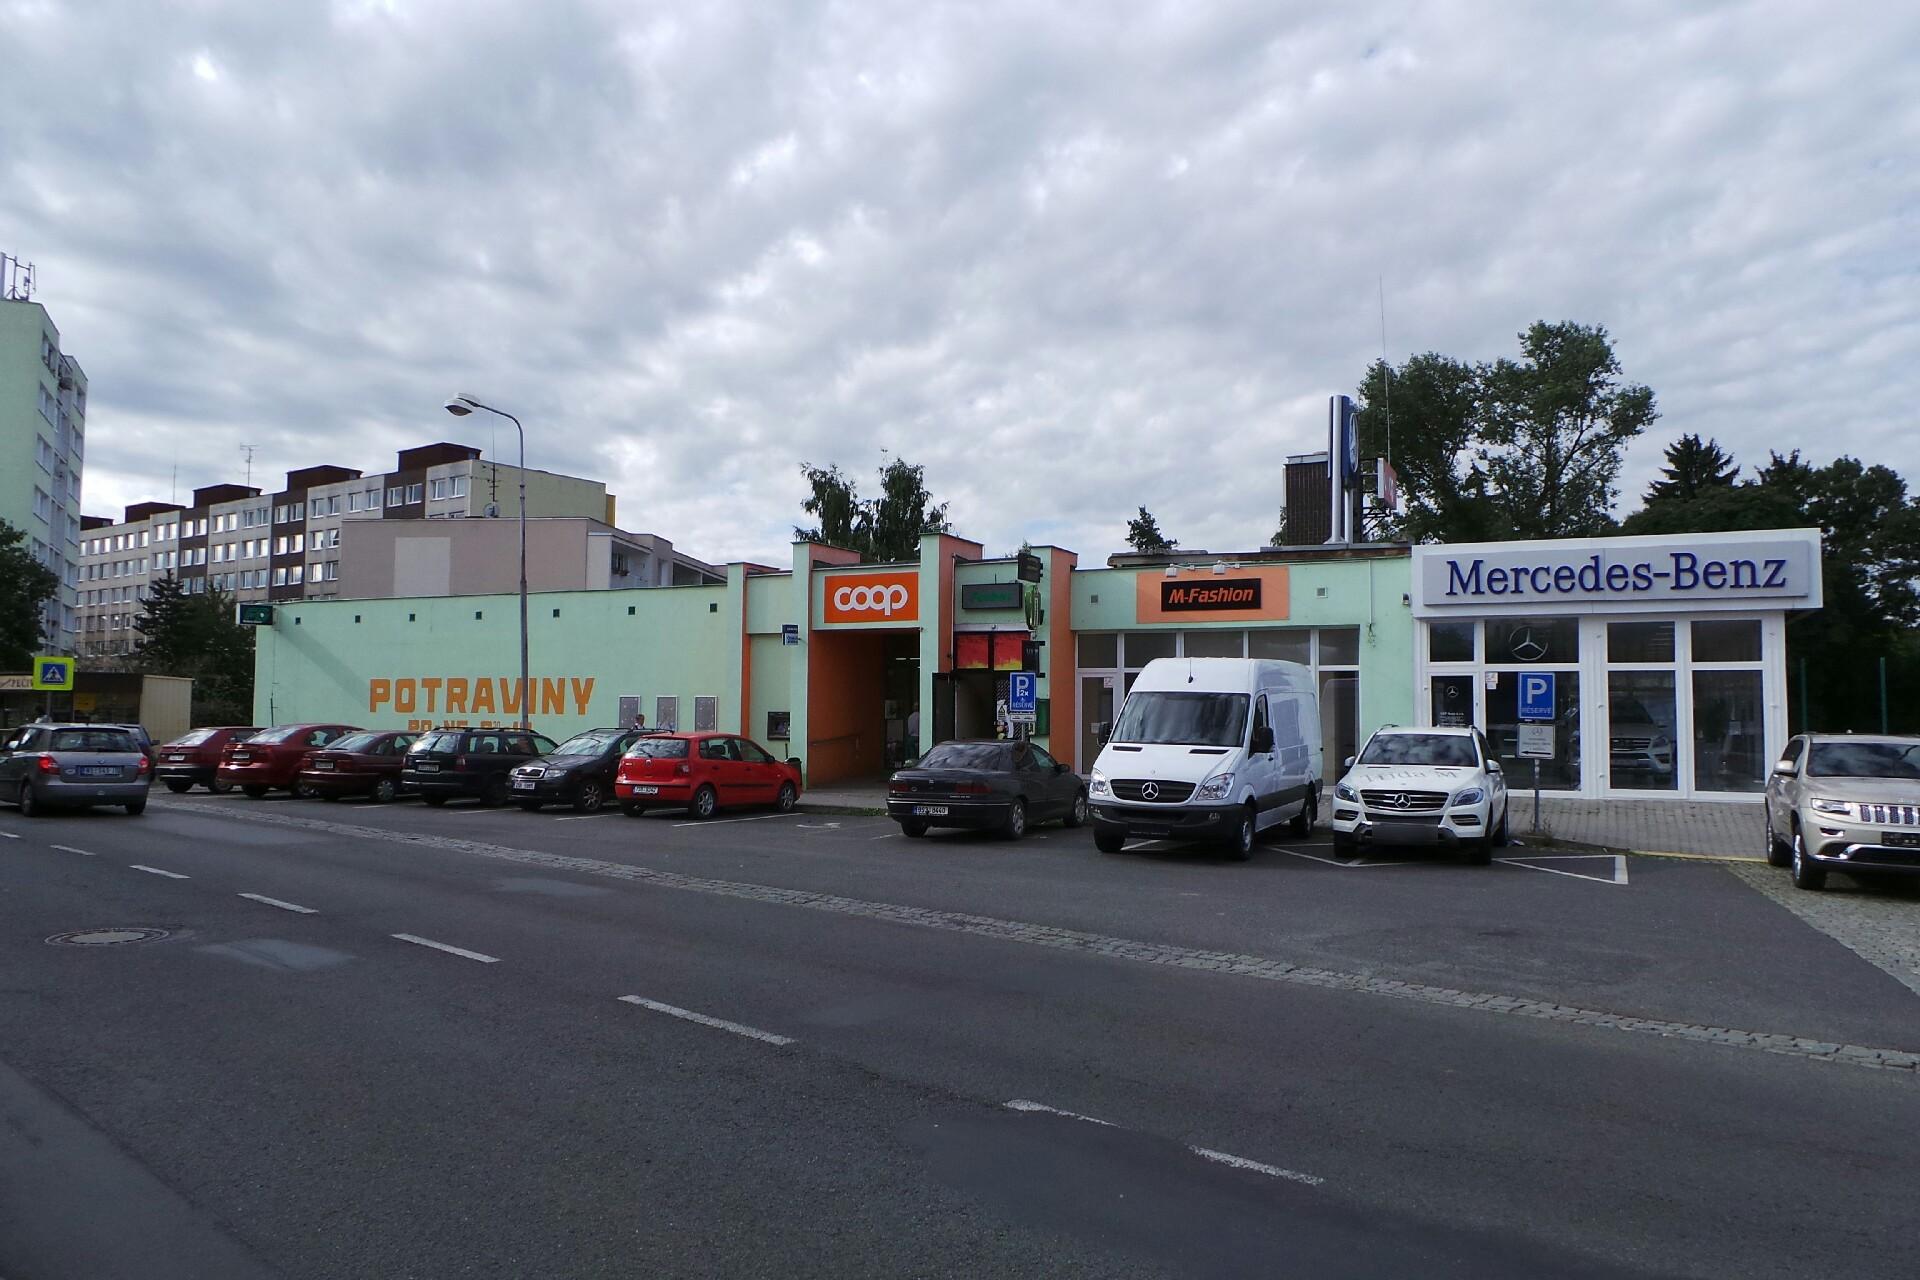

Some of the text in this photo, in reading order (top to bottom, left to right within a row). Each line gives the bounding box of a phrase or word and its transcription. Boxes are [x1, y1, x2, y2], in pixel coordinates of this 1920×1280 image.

[1445, 552, 1787, 595] Mercedes-Benz
[833, 584, 908, 616] coop
[1168, 587, 1254, 604] M-Fashion
[369, 677, 595, 715] POTRAVINY
[1016, 676, 1029, 697] P
[1527, 678, 1547, 704] P
